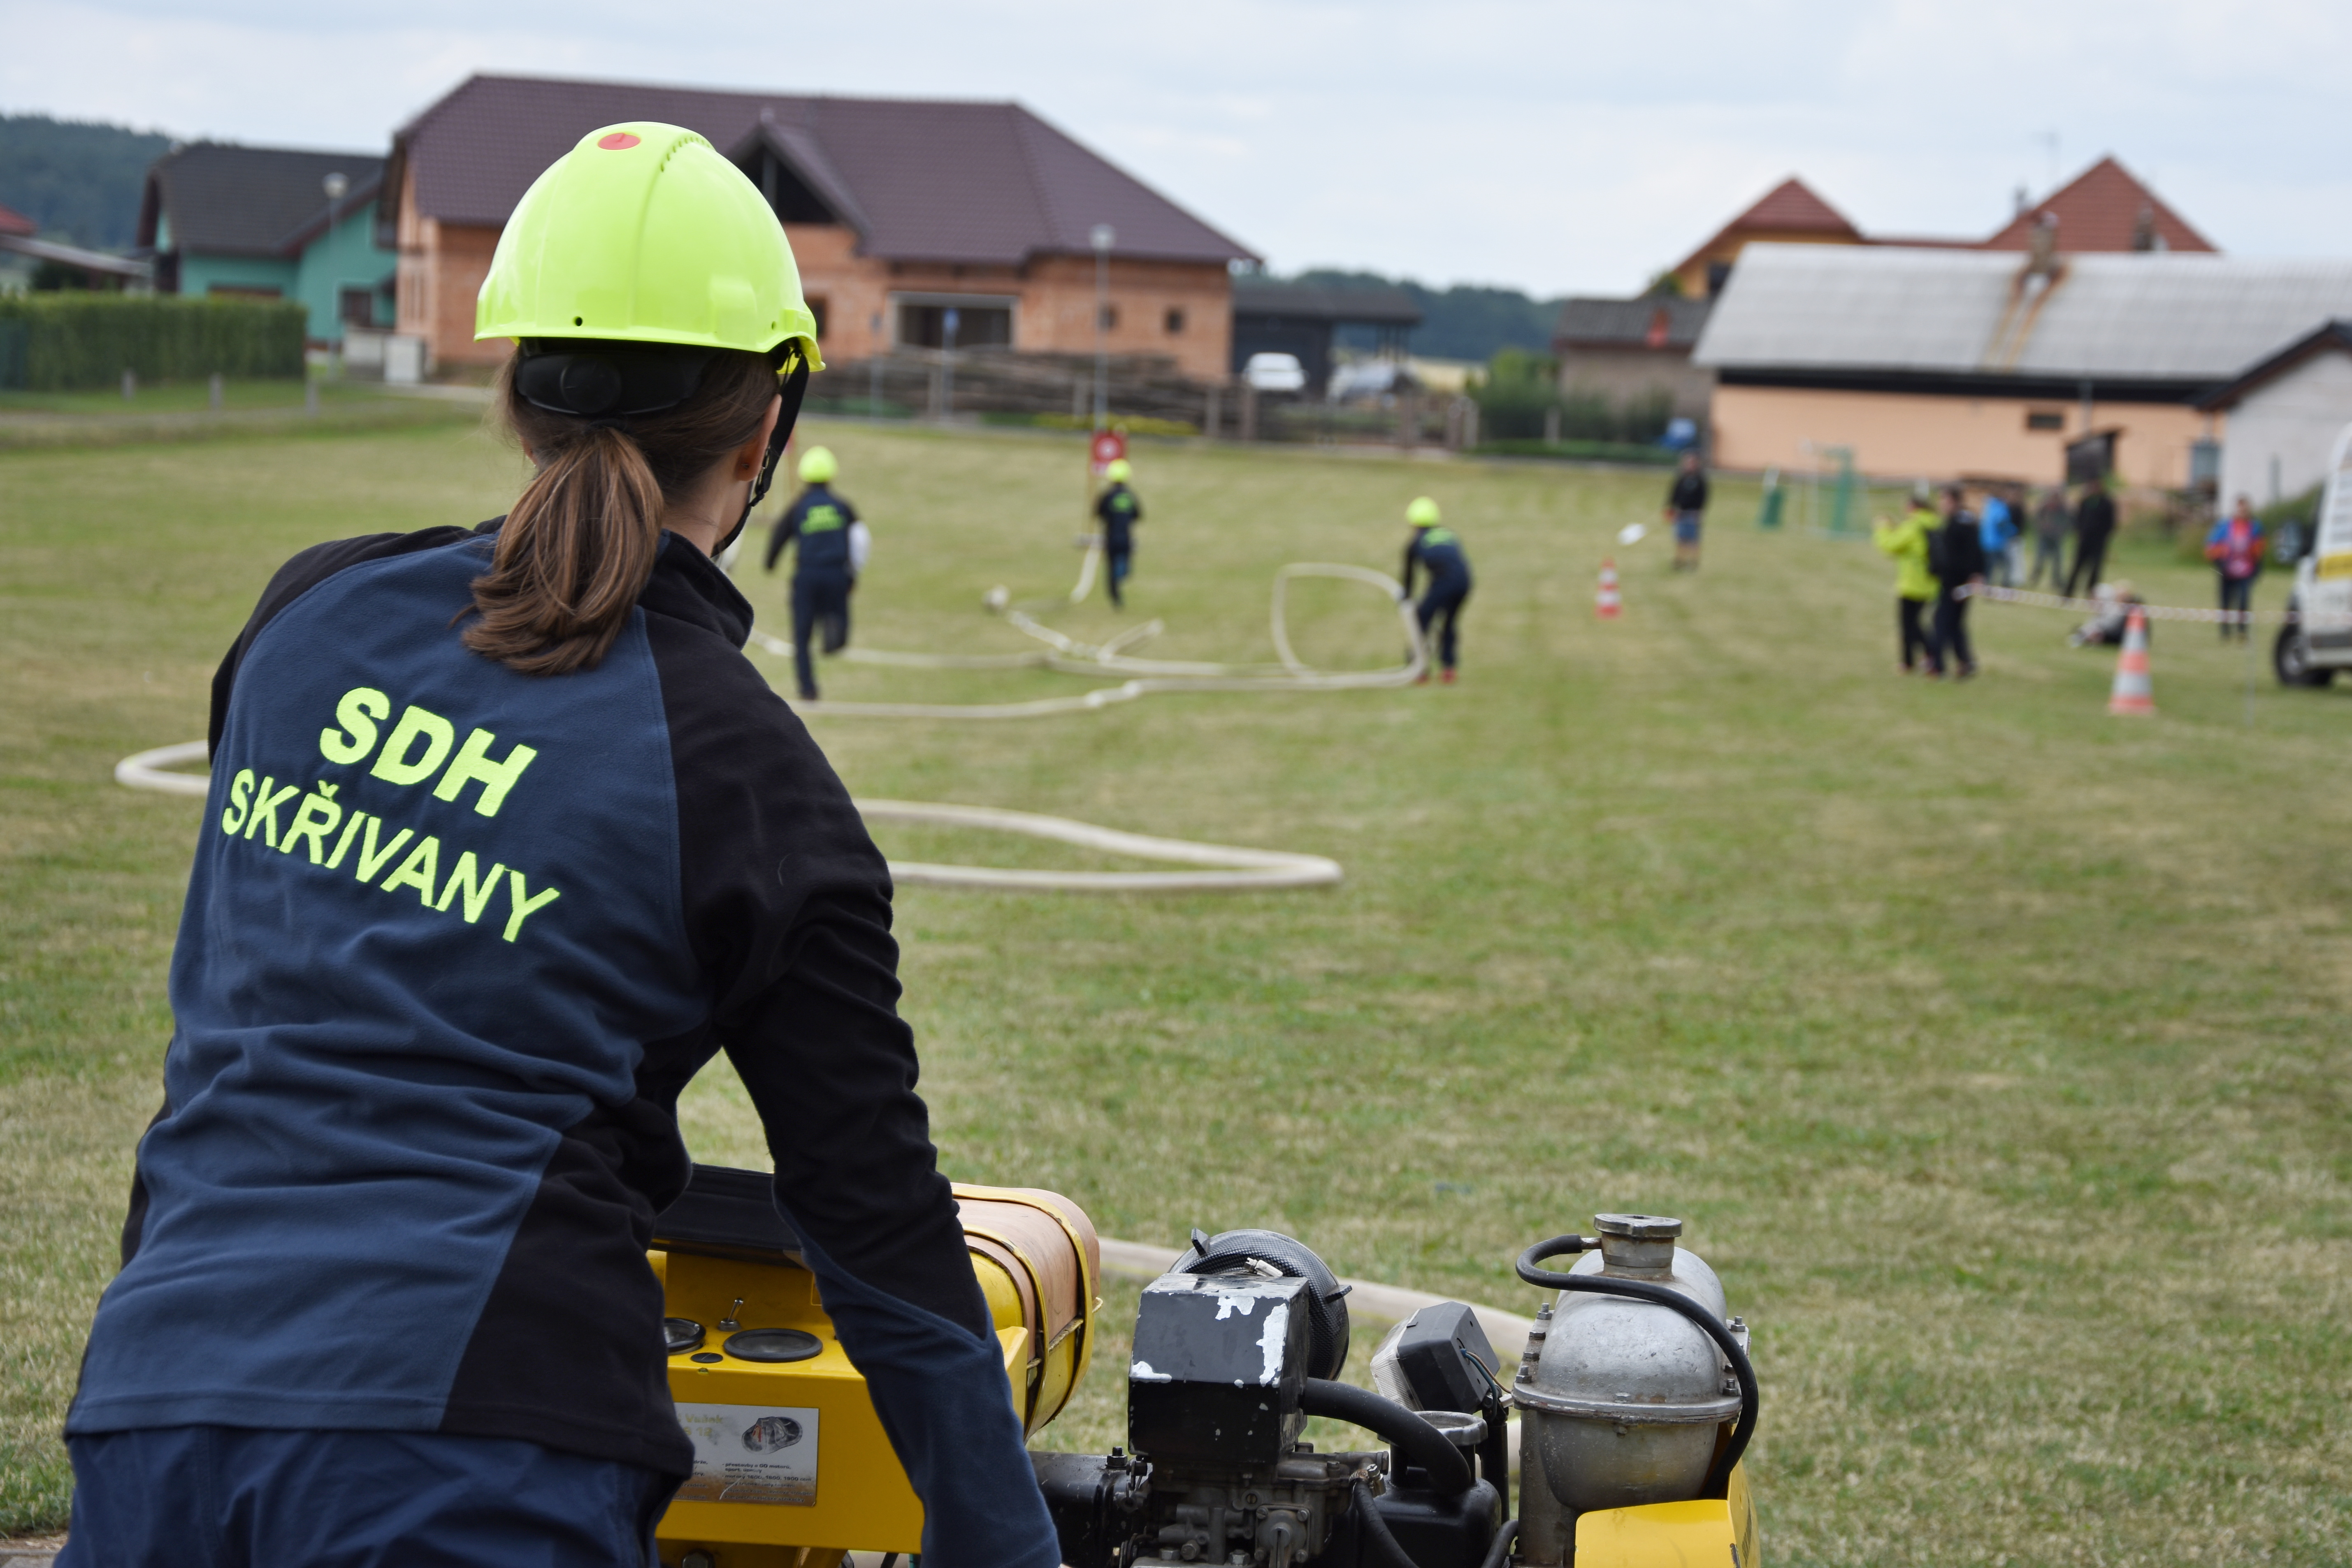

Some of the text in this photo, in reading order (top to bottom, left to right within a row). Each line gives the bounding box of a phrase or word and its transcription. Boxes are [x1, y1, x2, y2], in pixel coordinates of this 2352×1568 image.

[320, 687, 537, 817] SDH
[222, 769, 560, 943] SKŘIVANY
[697, 1426, 712, 1436] 12
